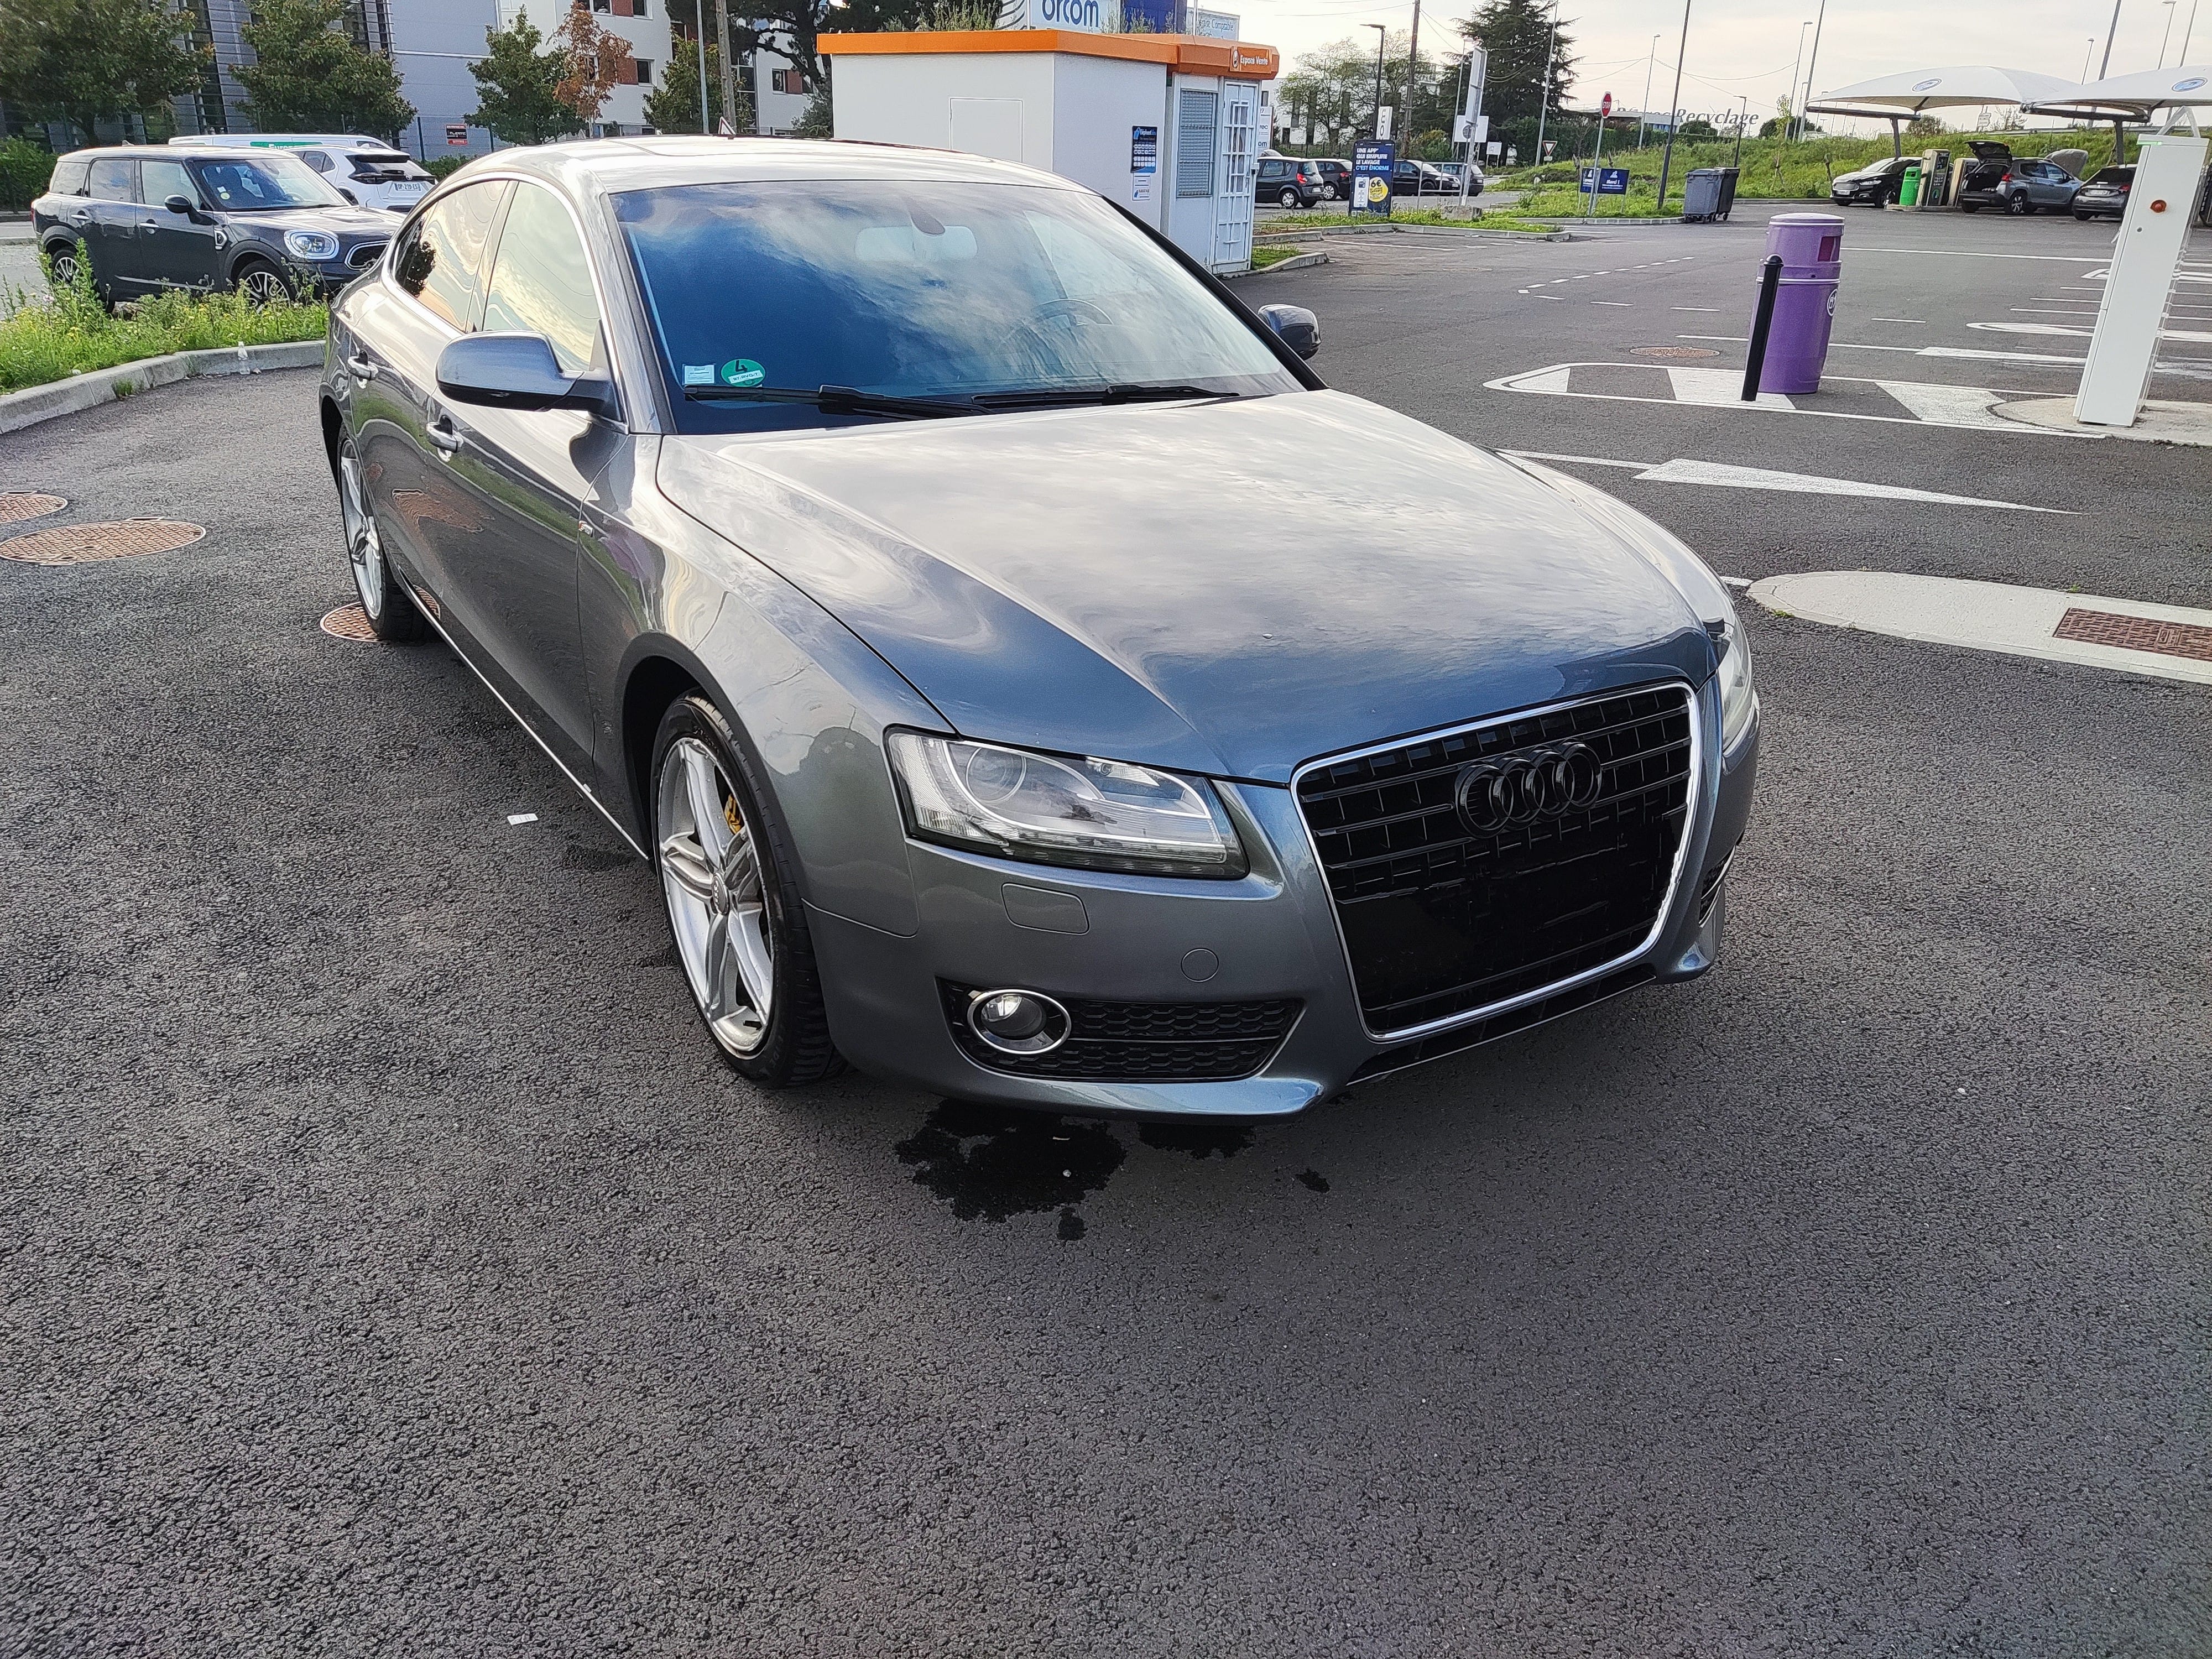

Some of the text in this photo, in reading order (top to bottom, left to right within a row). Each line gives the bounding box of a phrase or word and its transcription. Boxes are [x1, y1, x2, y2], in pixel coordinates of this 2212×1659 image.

[1042, 0, 1099, 27] orcom
[1212, 19, 1234, 32] Comptable
[1256, 55, 1268, 65] Vente
